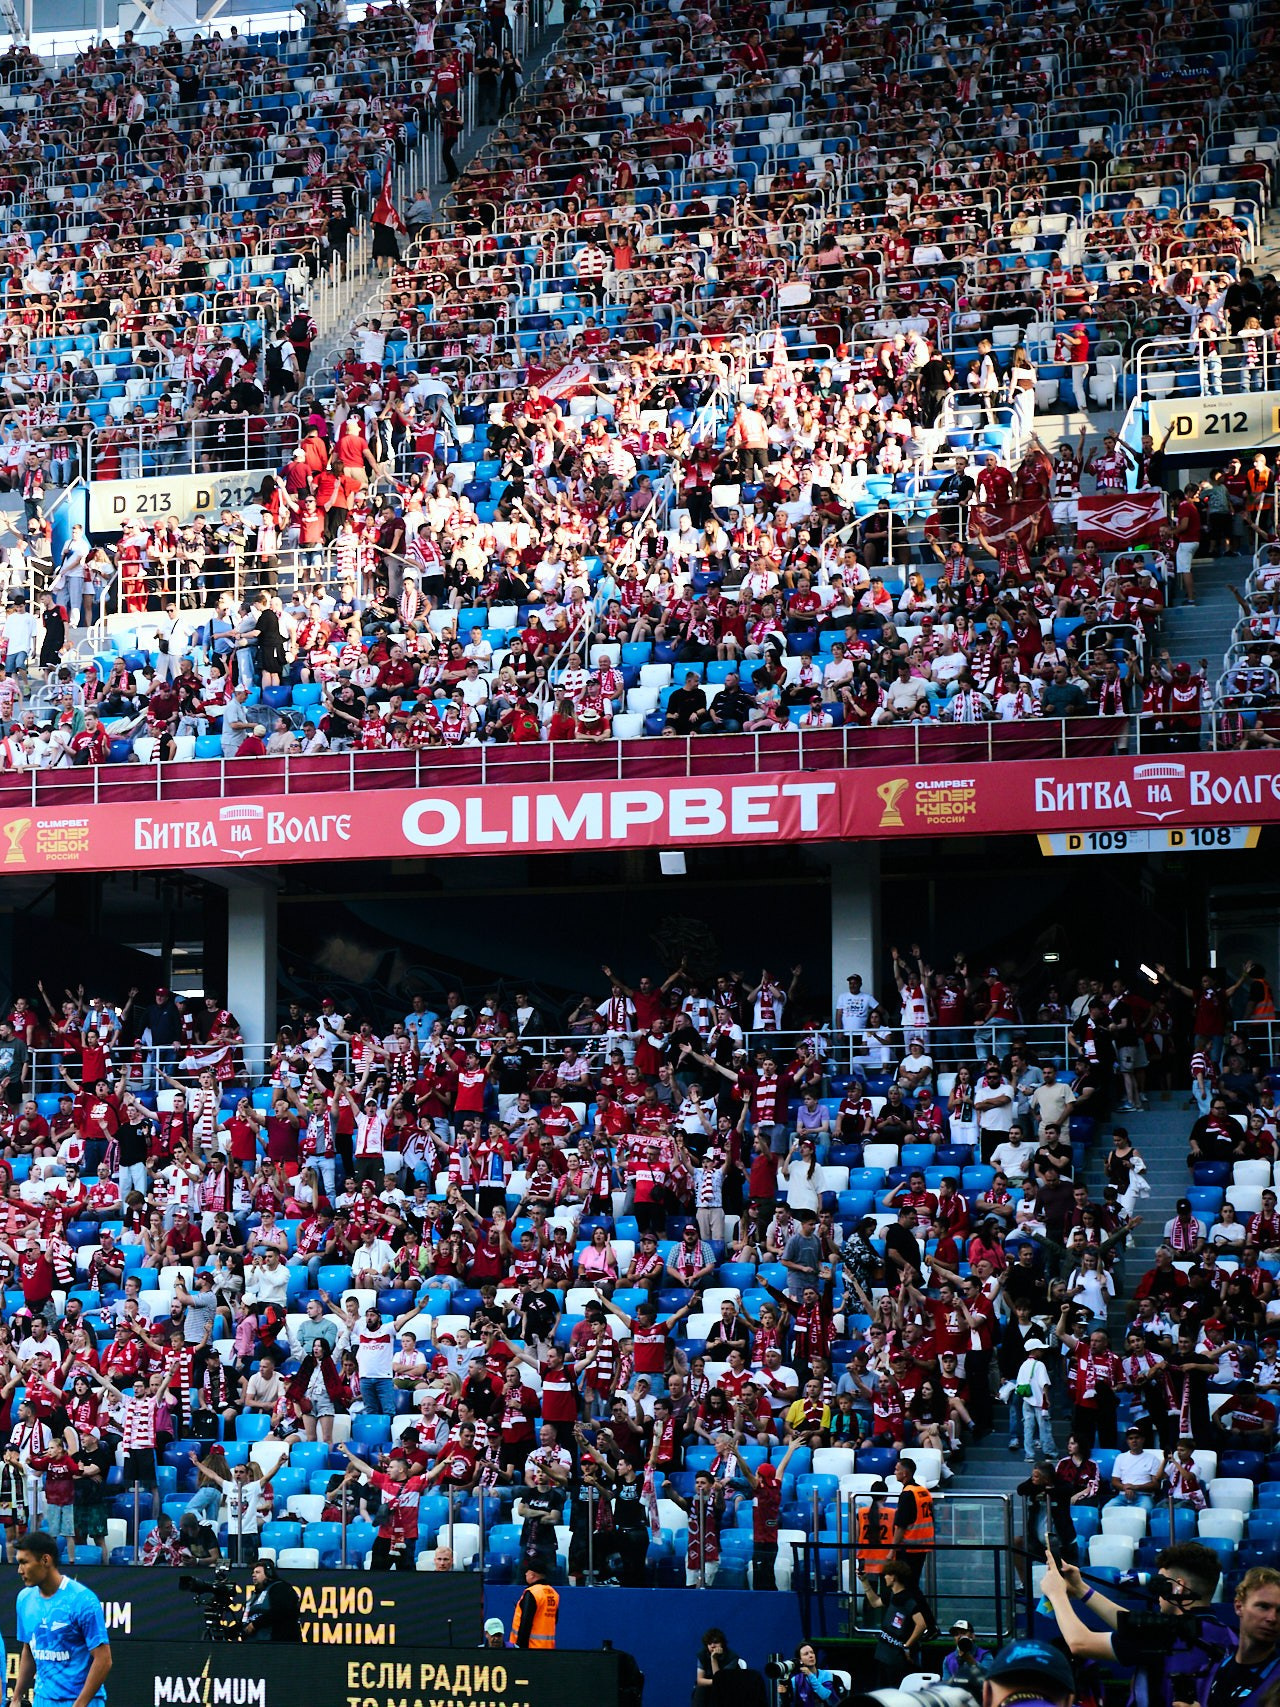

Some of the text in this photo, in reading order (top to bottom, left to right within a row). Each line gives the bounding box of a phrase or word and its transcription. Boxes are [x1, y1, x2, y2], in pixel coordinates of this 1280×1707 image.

[1177, 412, 1249, 436] D 212
[113, 492, 171, 513] D 213
[196, 486, 255, 508] D 212
[915, 779, 975, 789] OLIMPBET
[916, 789, 976, 803] СУПЕР
[402, 782, 835, 848] OLIMPBET
[916, 802, 976, 815] КУБОК
[36, 818, 89, 828] OLIMPBET
[927, 815, 965, 824] РОССИИ
[37, 828, 89, 841] СУПЕР
[1069, 832, 1127, 850] D 109
[1171, 828, 1231, 847] D 108
[36, 840, 89, 852] КУБОК
[45, 852, 79, 861] РОССИИ
[300, 1587, 373, 1618] АДИО
[155, 1669, 265, 1707] MAXIMUM
[347, 1662, 412, 1690] ЕСЛИ
[421, 1664, 507, 1698] РАДИО
